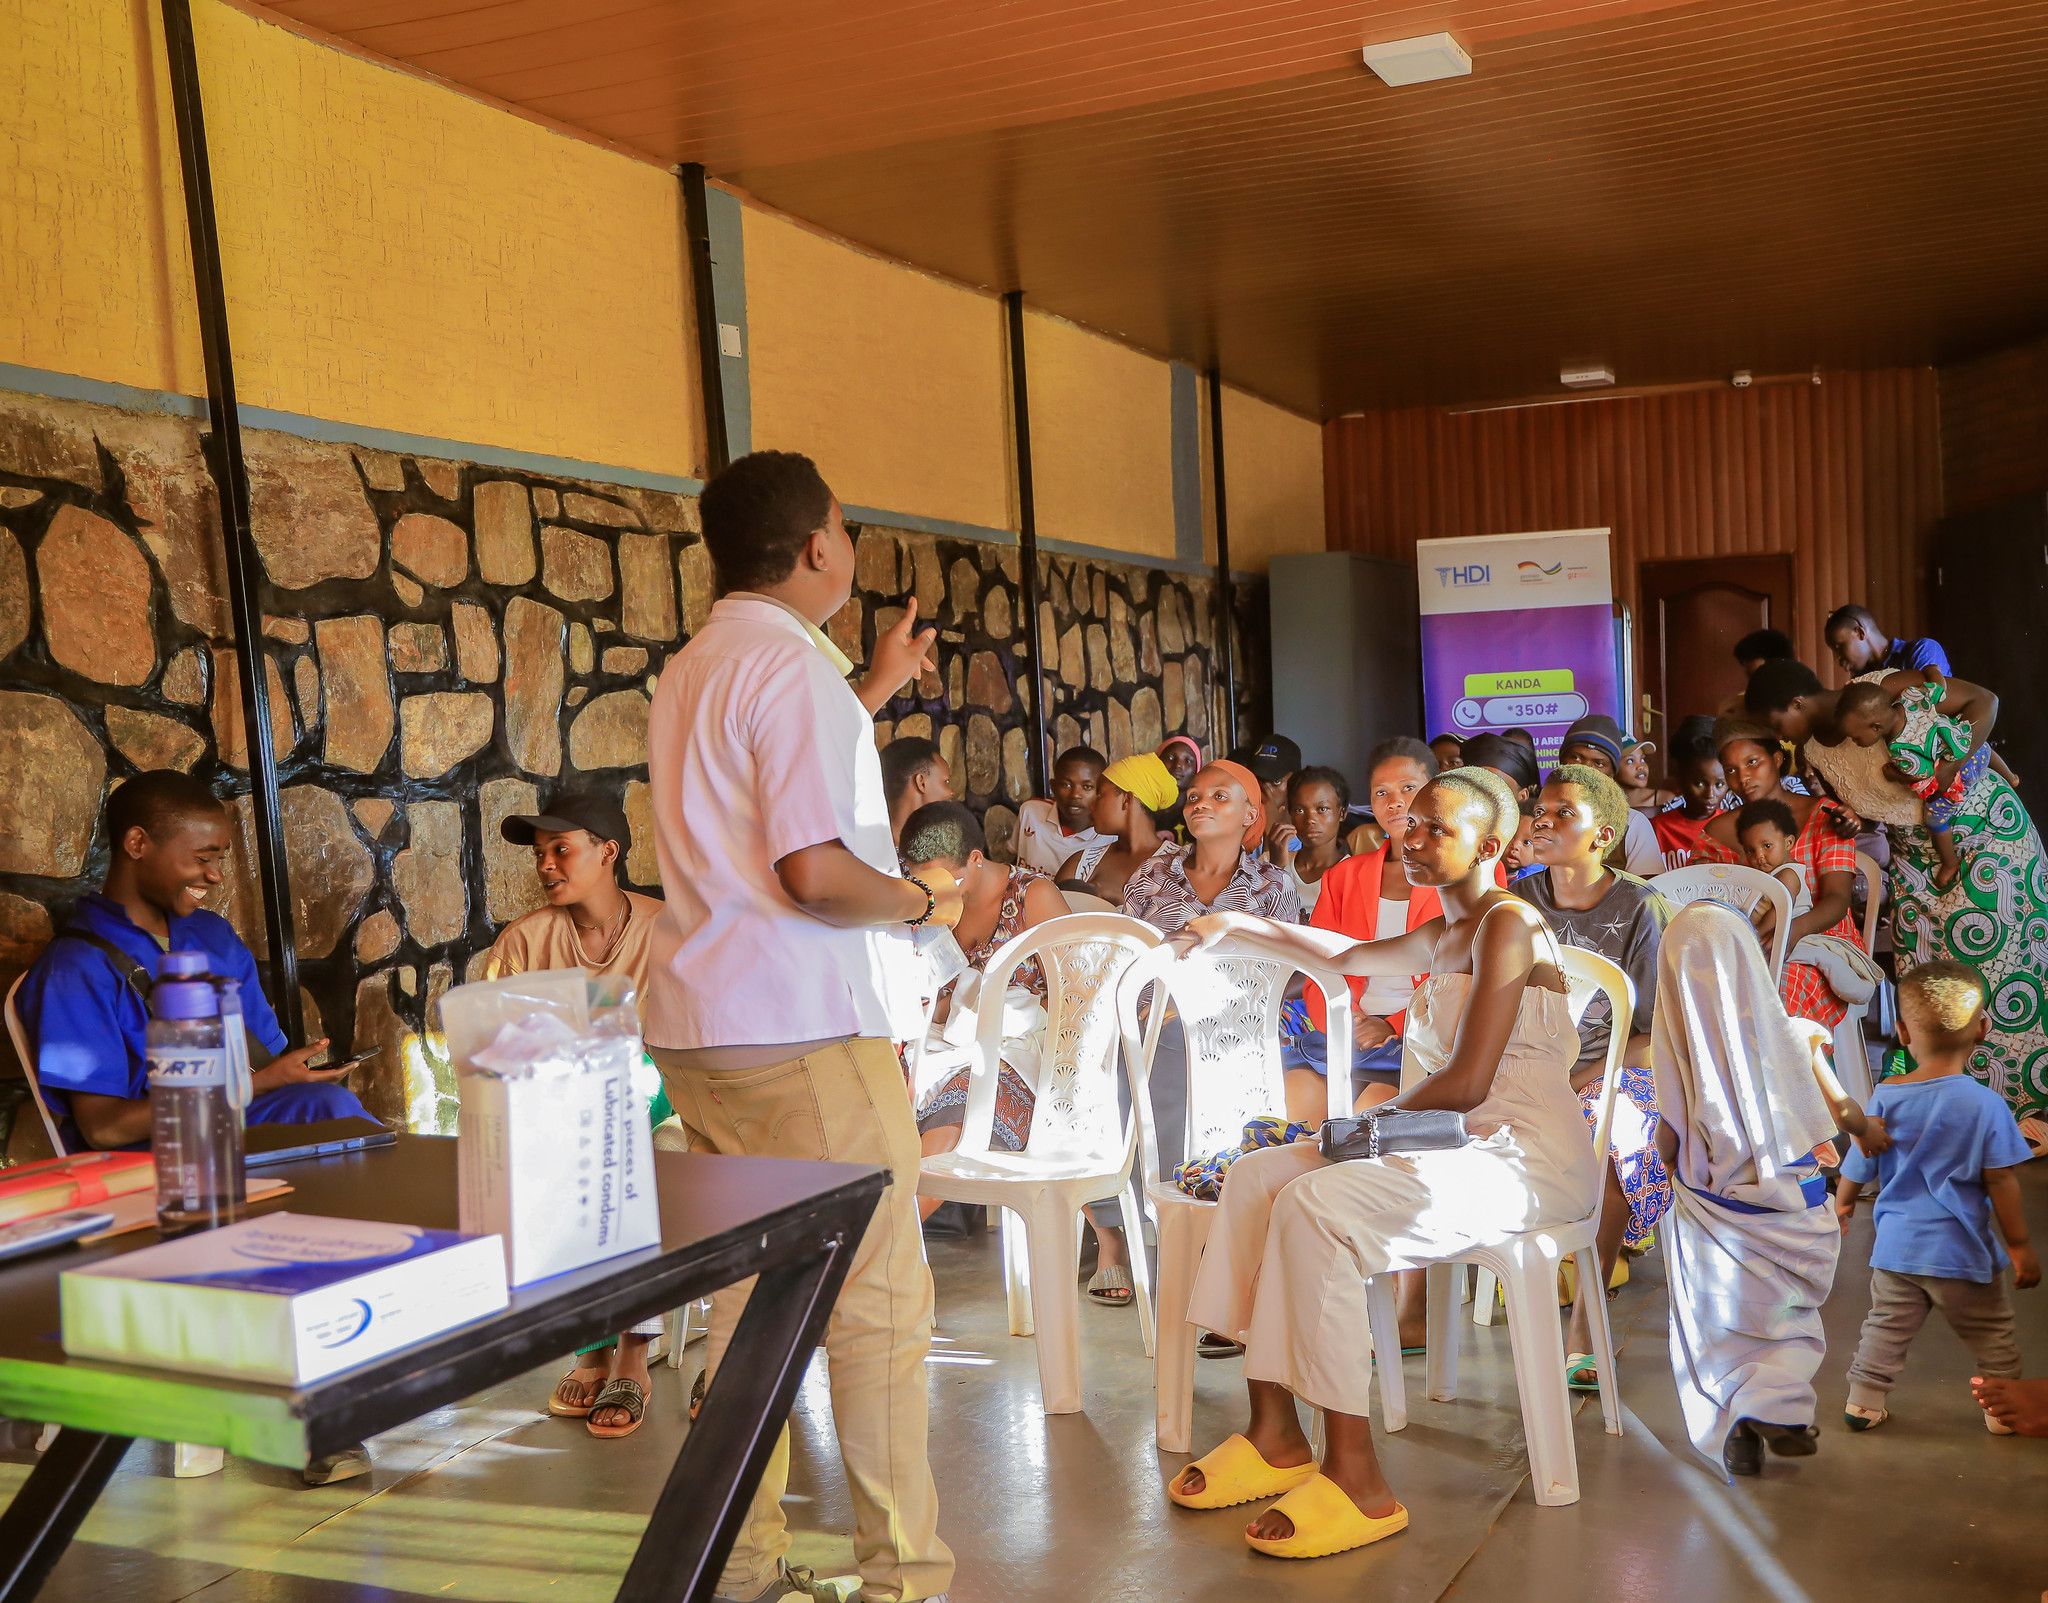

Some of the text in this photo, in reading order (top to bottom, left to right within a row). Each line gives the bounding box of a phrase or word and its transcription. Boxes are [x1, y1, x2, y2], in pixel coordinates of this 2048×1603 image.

[1453, 564, 1490, 584] HDI
[1496, 678, 1542, 690] KANDA
[624, 1119, 634, 1176] pieces
[598, 1077, 619, 1247] Lubricated condoms
[625, 1183, 638, 1201] of
